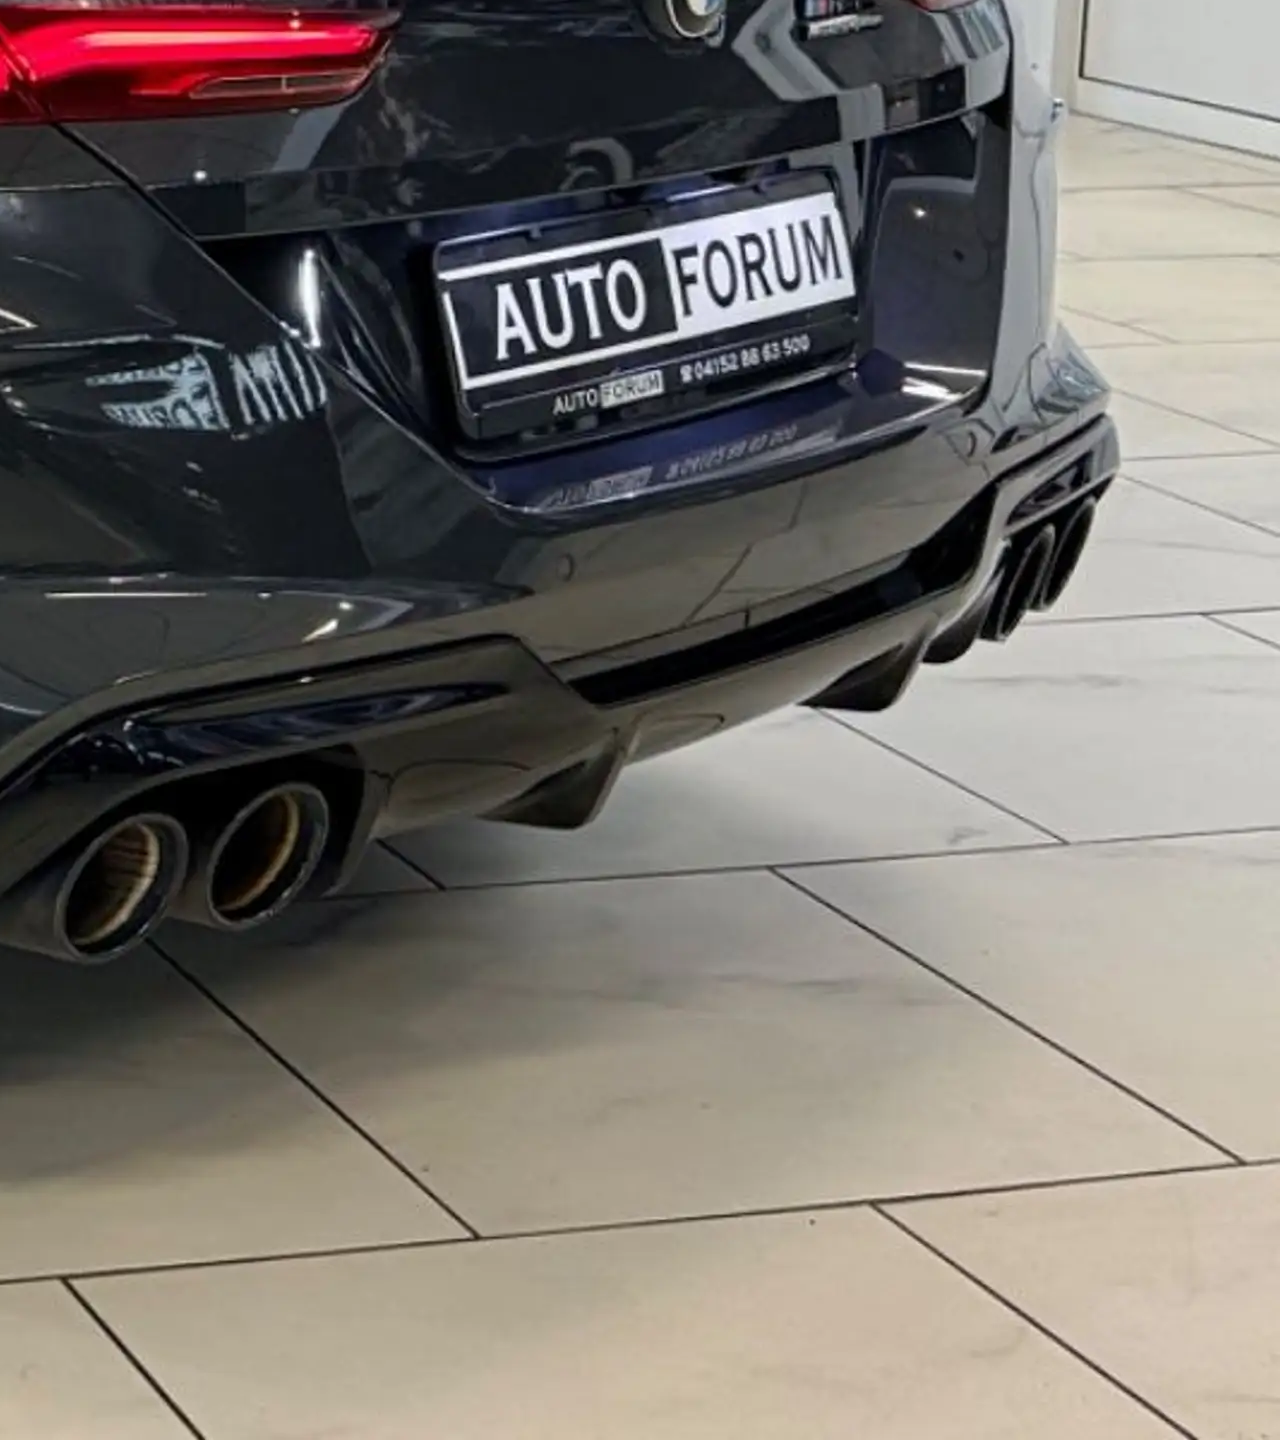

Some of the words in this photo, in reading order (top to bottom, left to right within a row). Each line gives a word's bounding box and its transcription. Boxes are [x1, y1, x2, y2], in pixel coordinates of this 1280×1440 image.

[496, 258, 647, 361] AUTO
[671, 214, 843, 318] FORUM
[552, 387, 598, 416] AUTO
[602, 373, 662, 406] FORUM
[694, 351, 739, 380] 04152
